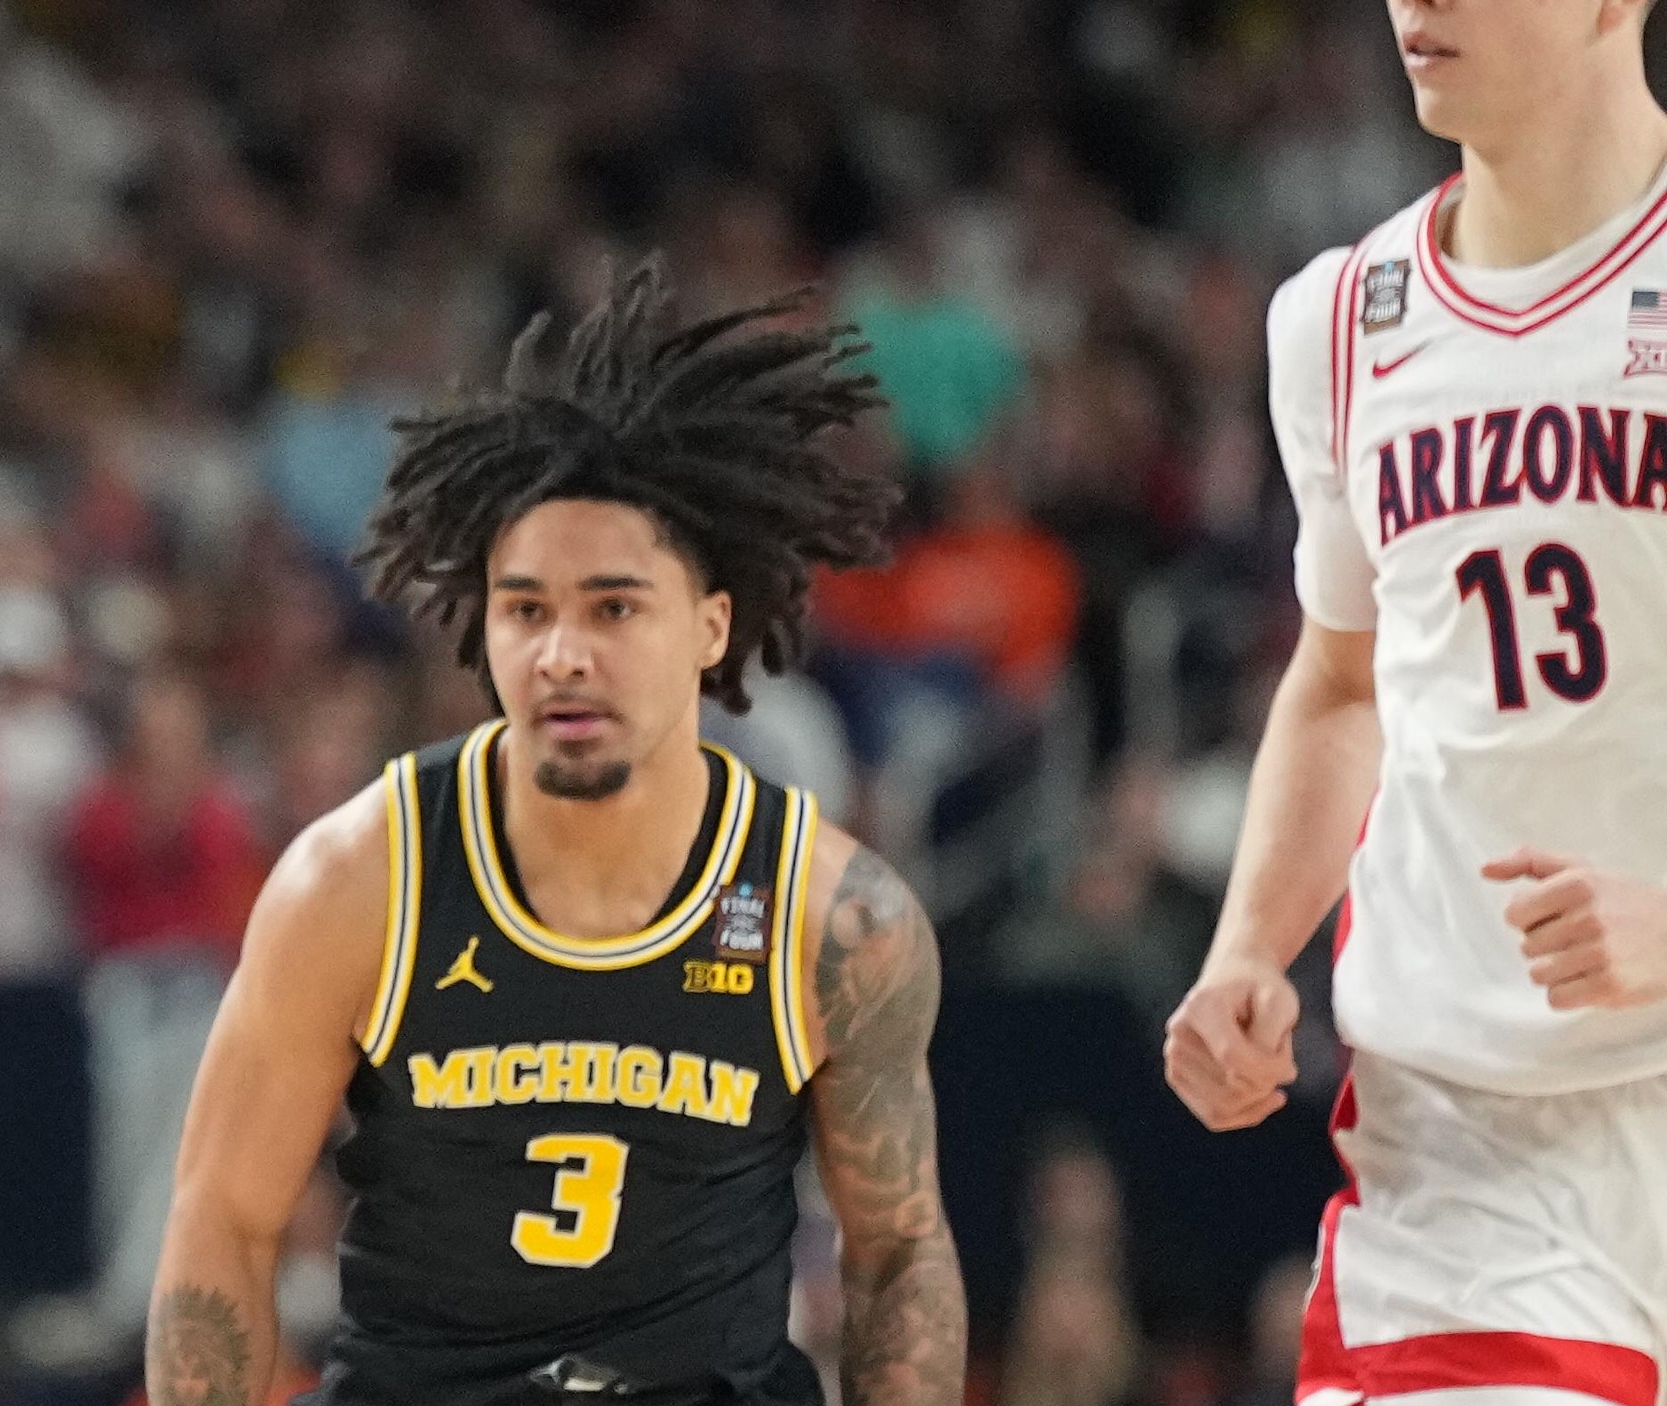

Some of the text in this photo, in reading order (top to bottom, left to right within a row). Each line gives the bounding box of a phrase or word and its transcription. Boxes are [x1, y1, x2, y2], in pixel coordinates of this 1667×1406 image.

[1378, 404, 1667, 546] ARIZONA
[1455, 542, 1609, 712] 13
[407, 1040, 760, 1127] MICHIGAN
[510, 1131, 630, 1269] 3
